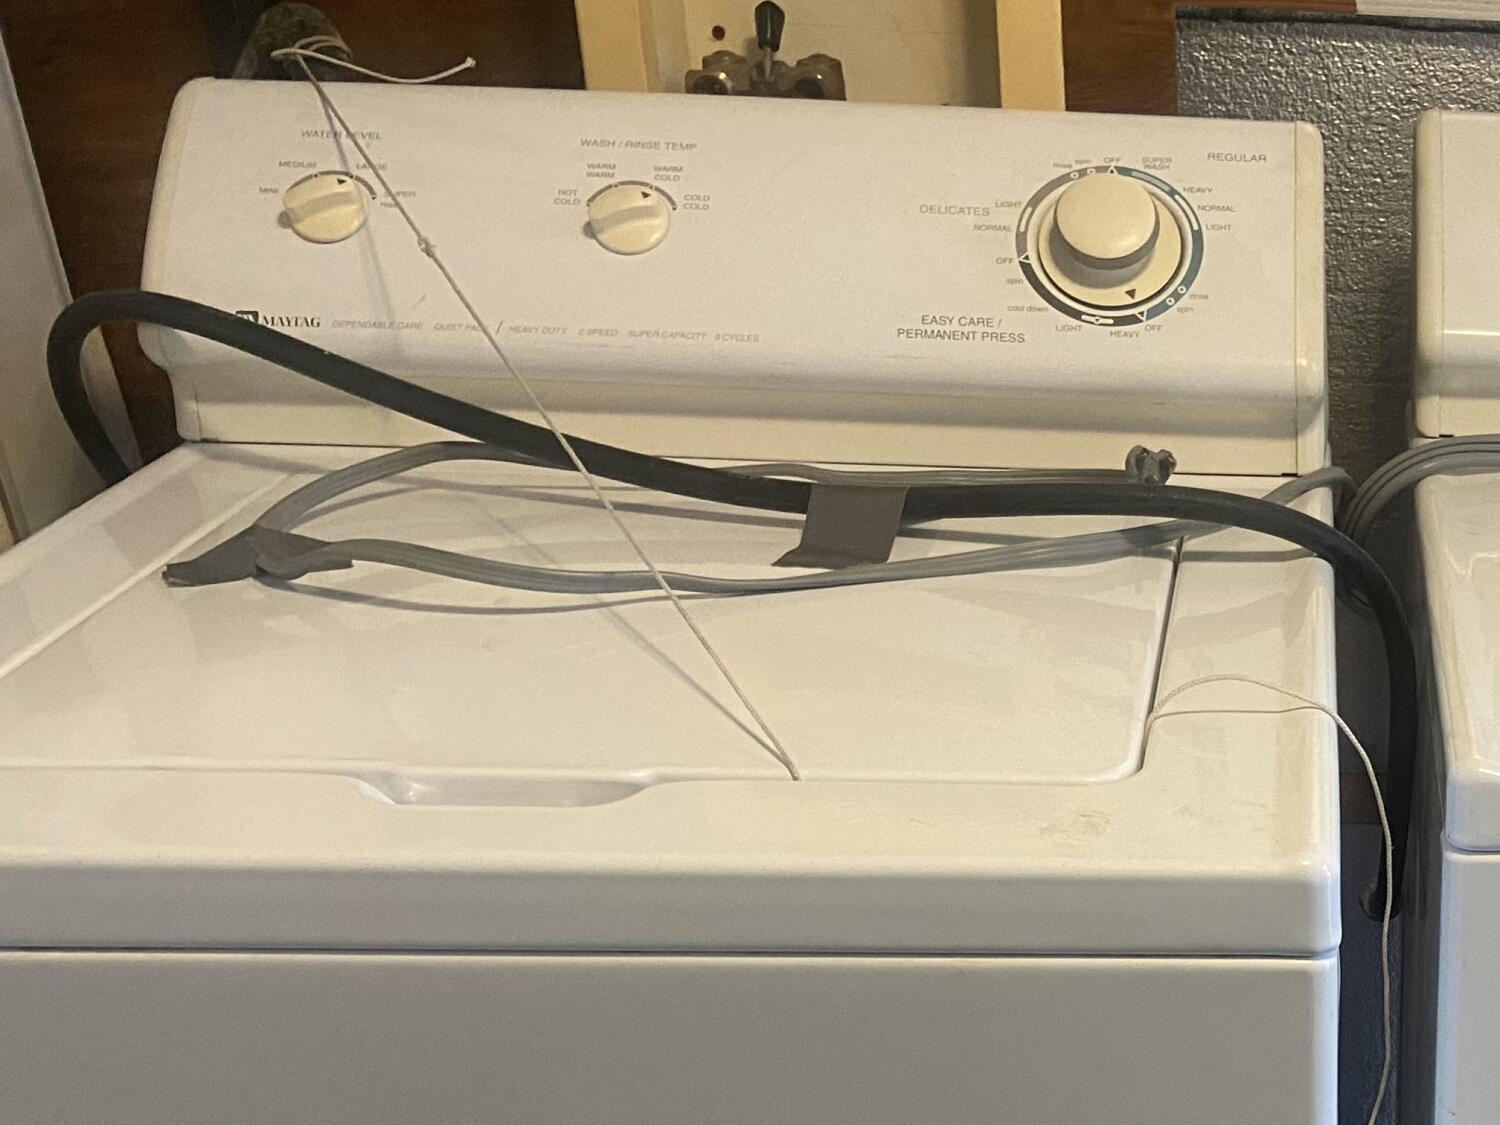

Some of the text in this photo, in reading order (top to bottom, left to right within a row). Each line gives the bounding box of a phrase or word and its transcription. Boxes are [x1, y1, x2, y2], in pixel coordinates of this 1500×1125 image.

[581, 138, 616, 148] WASH
[624, 140, 660, 150] RINSE
[664, 141, 697, 151] TEMP
[1207, 152, 1267, 163] REGULAR
[278, 160, 317, 168] MEDIUM
[653, 165, 684, 173] WARM
[586, 171, 616, 179] WARM
[558, 189, 578, 197] HOT
[1183, 186, 1213, 194] HEAVY
[554, 198, 581, 206] COLD
[684, 193, 711, 202] COLD
[683, 202, 710, 211] COLD
[995, 201, 1022, 209] LIGHT
[1197, 204, 1236, 213] NORMAL
[919, 203, 990, 217] DELICATES
[973, 224, 1012, 233] NORMAL
[1205, 223, 1232, 232] LIGHT
[996, 257, 1014, 265] OFF
[1006, 277, 1024, 286] spin
[1007, 304, 1049, 313] cool down
[1177, 307, 1194, 315] spin
[921, 314, 954, 326] EASY
[958, 316, 994, 327] CARE
[262, 315, 321, 328] MAYTAG
[586, 328, 619, 337] SPEED
[1055, 324, 1083, 333] LIGHT
[1144, 324, 1163, 332] OFF
[897, 328, 1026, 344] PERMANENT PRESS
[1109, 330, 1140, 338] HEAVY
